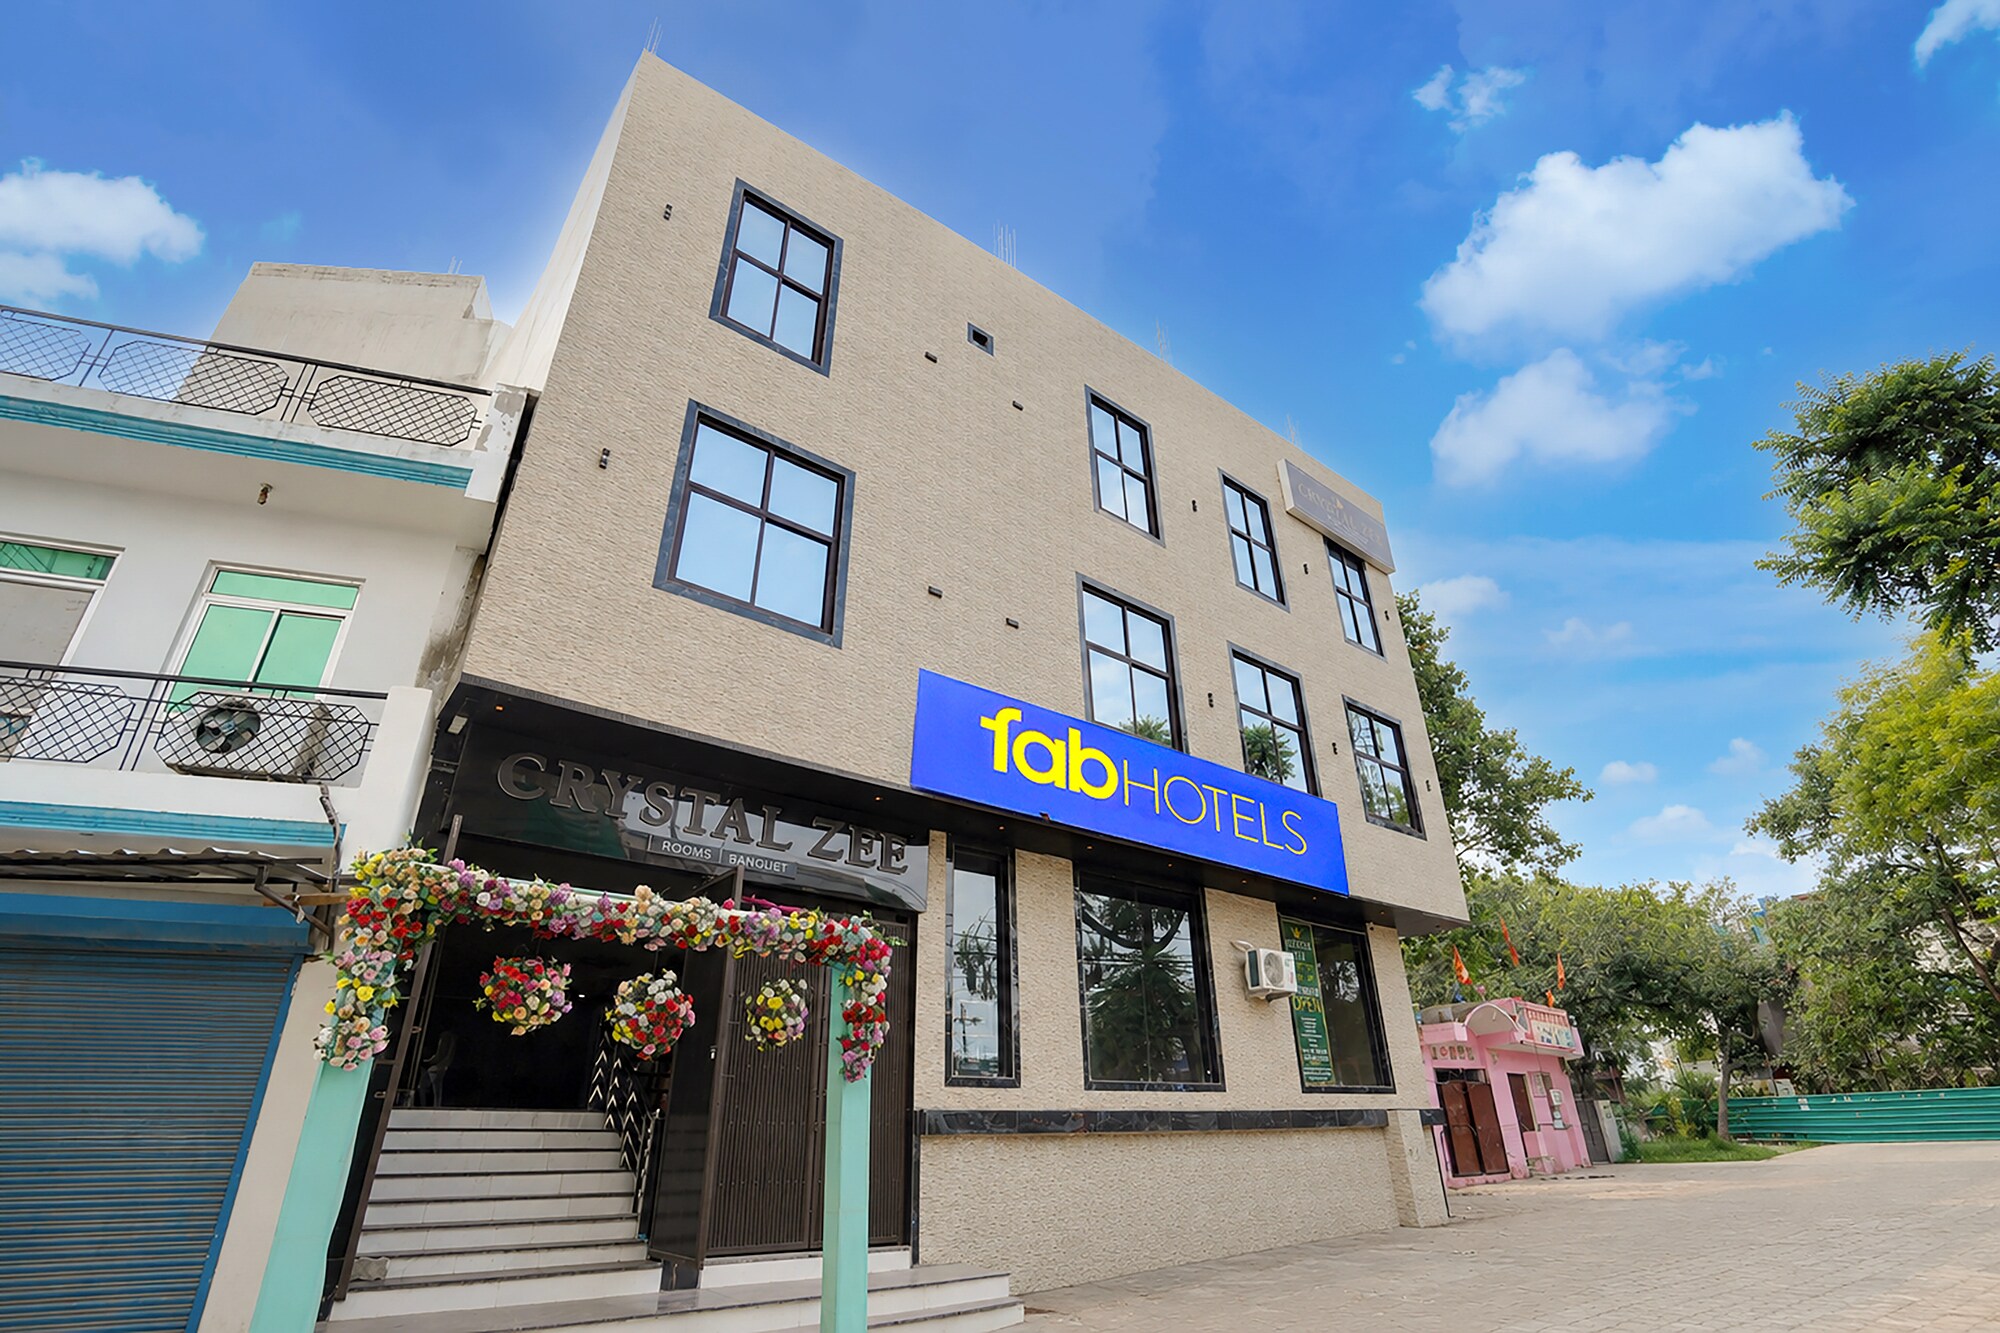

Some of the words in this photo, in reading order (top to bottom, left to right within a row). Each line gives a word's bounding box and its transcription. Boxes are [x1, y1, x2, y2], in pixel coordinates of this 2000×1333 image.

[496, 752, 793, 852] CRYSTAL
[806, 816, 911, 875] ZEE
[661, 840, 712, 860] ROOMS
[728, 853, 788, 873] BANQUET
